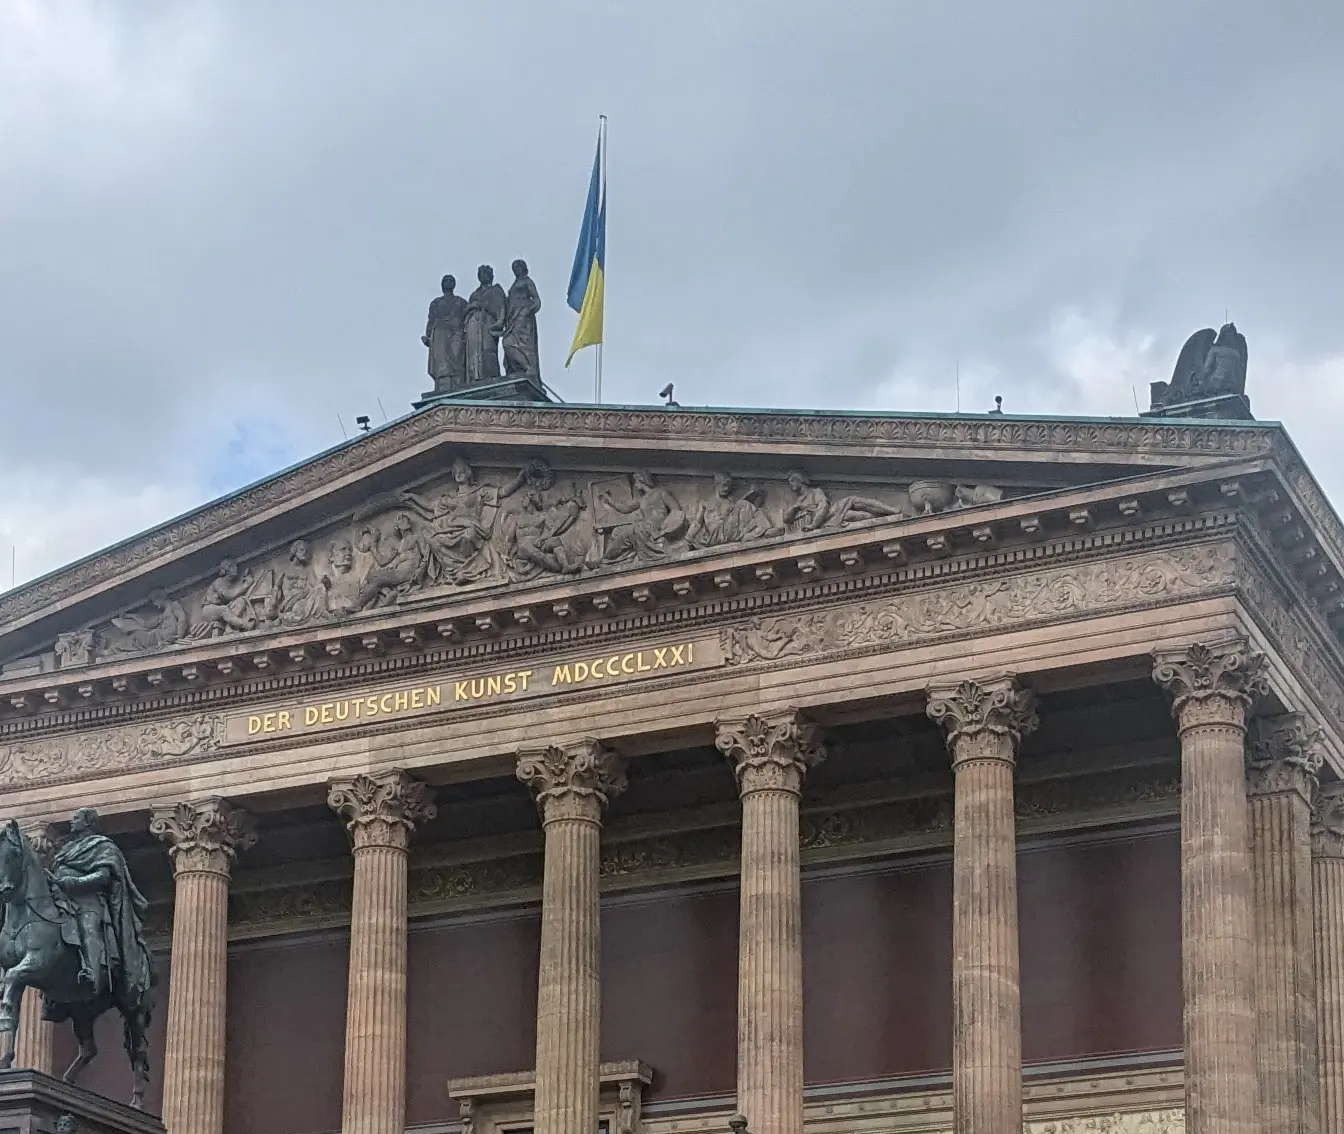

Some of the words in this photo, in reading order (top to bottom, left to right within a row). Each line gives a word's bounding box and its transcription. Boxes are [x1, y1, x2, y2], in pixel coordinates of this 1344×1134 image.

[248, 711, 292, 735] DER
[305, 686, 441, 726] DEUTSCHEN
[455, 670, 532, 701] KUNST
[552, 643, 694, 686] MDCCCLXXI
